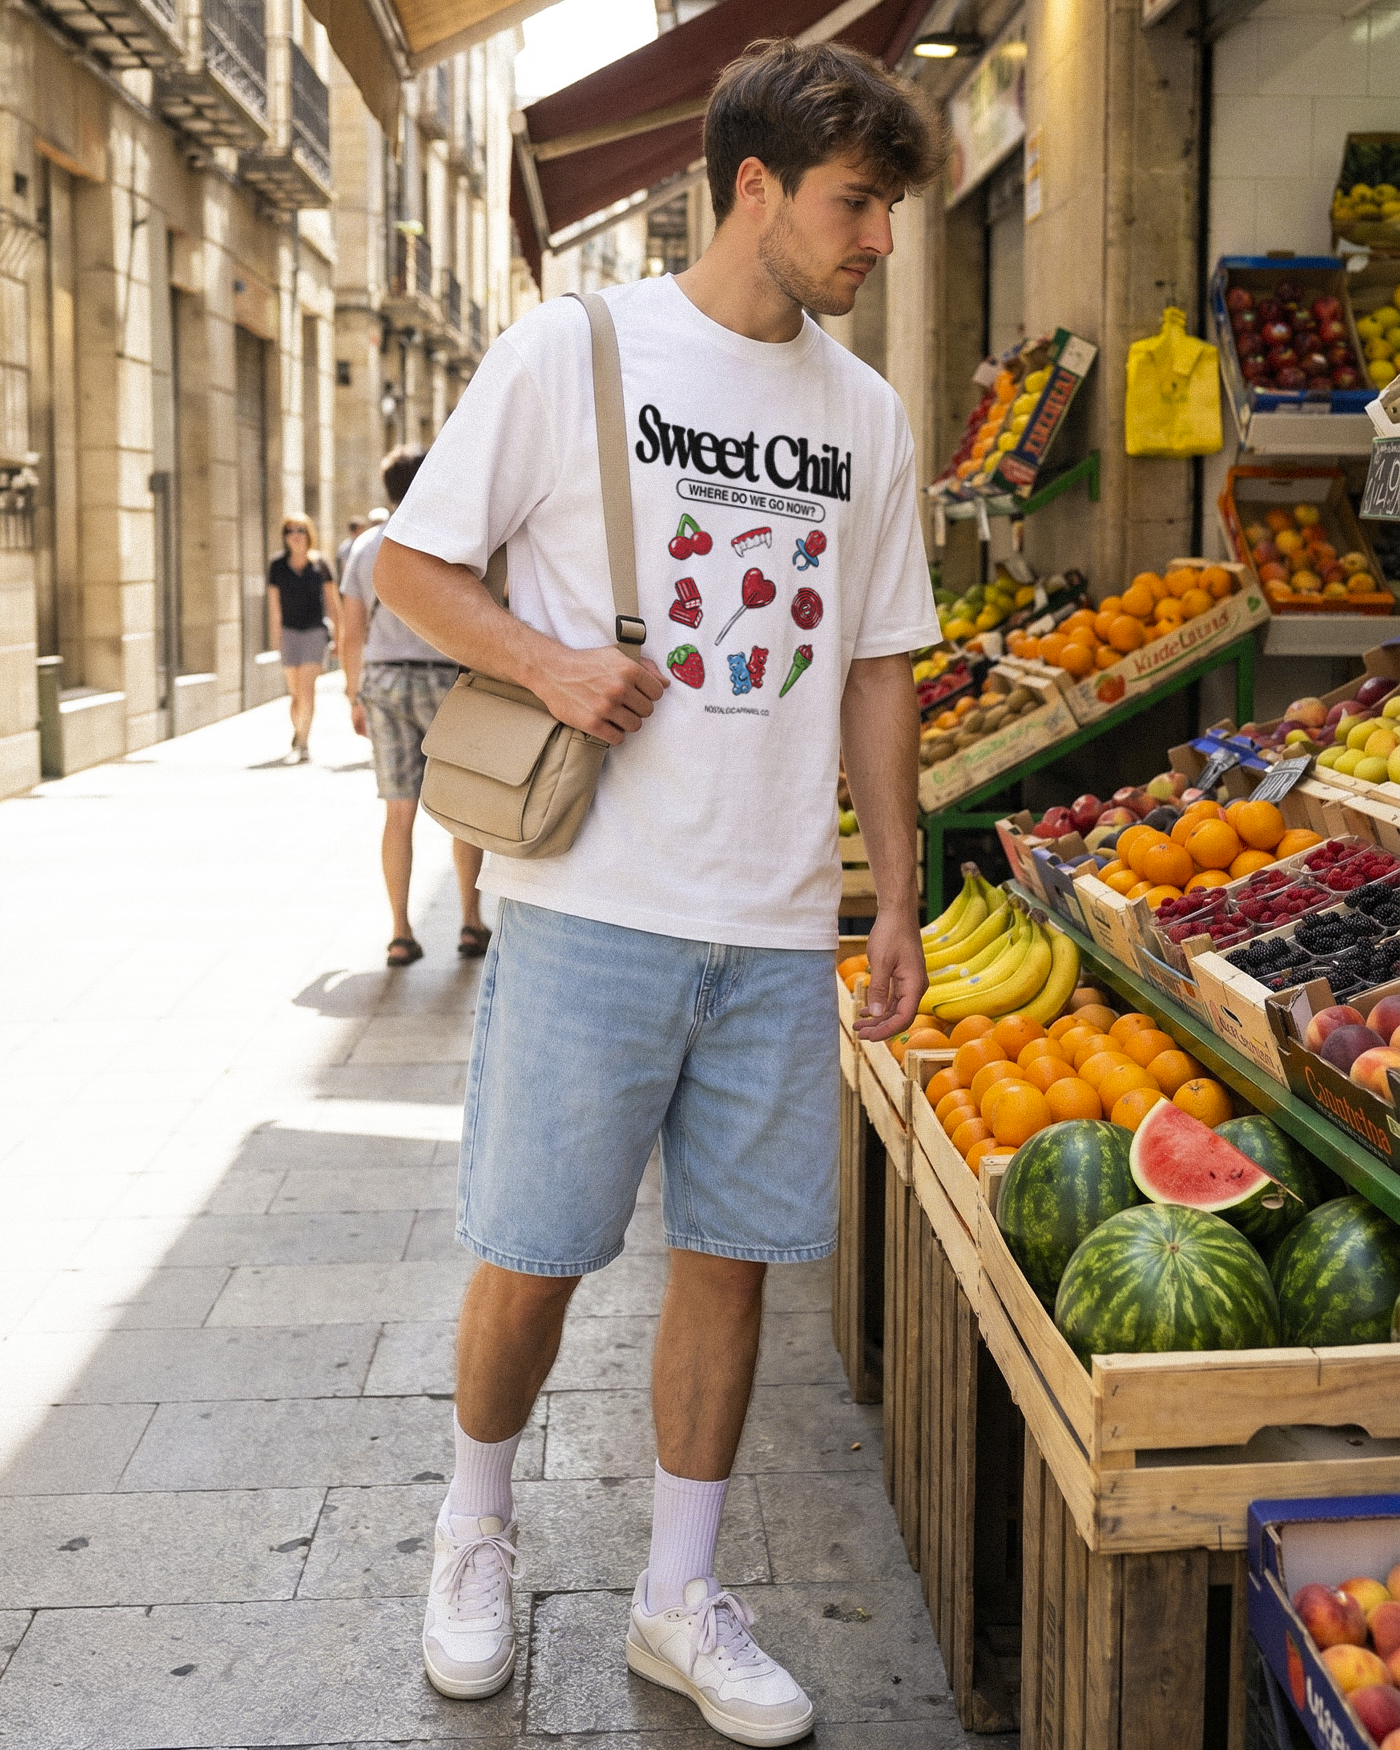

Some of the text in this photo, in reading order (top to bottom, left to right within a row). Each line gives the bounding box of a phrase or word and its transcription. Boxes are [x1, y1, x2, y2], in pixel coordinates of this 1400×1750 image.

[636, 404, 852, 502] Sweet Child
[689, 483, 816, 517] WHERE DO WE GO NOW?
